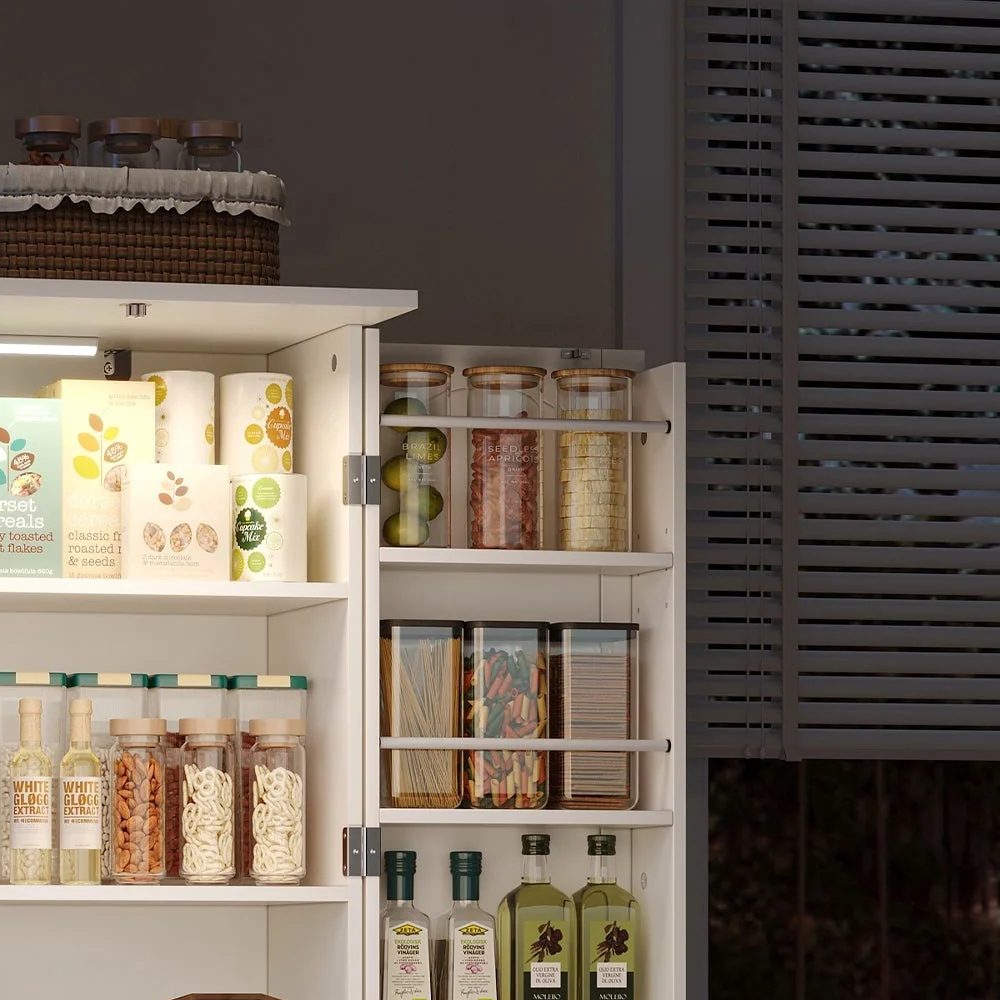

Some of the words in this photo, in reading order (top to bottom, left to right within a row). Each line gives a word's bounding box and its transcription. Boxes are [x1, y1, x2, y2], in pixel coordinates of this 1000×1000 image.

[402, 442, 441, 451] BRAZIL
[405, 453, 440, 461] LIMES
[9, 531, 54, 542] toasted
[67, 530, 110, 541] classic
[7, 543, 44, 554] flakes
[68, 543, 115, 554] roasted
[81, 556, 116, 567] seeds
[13, 781, 48, 793] WHITE
[63, 781, 99, 793] WHITE
[13, 806, 48, 815] EXTRACT
[64, 806, 99, 815] EXTRACT
